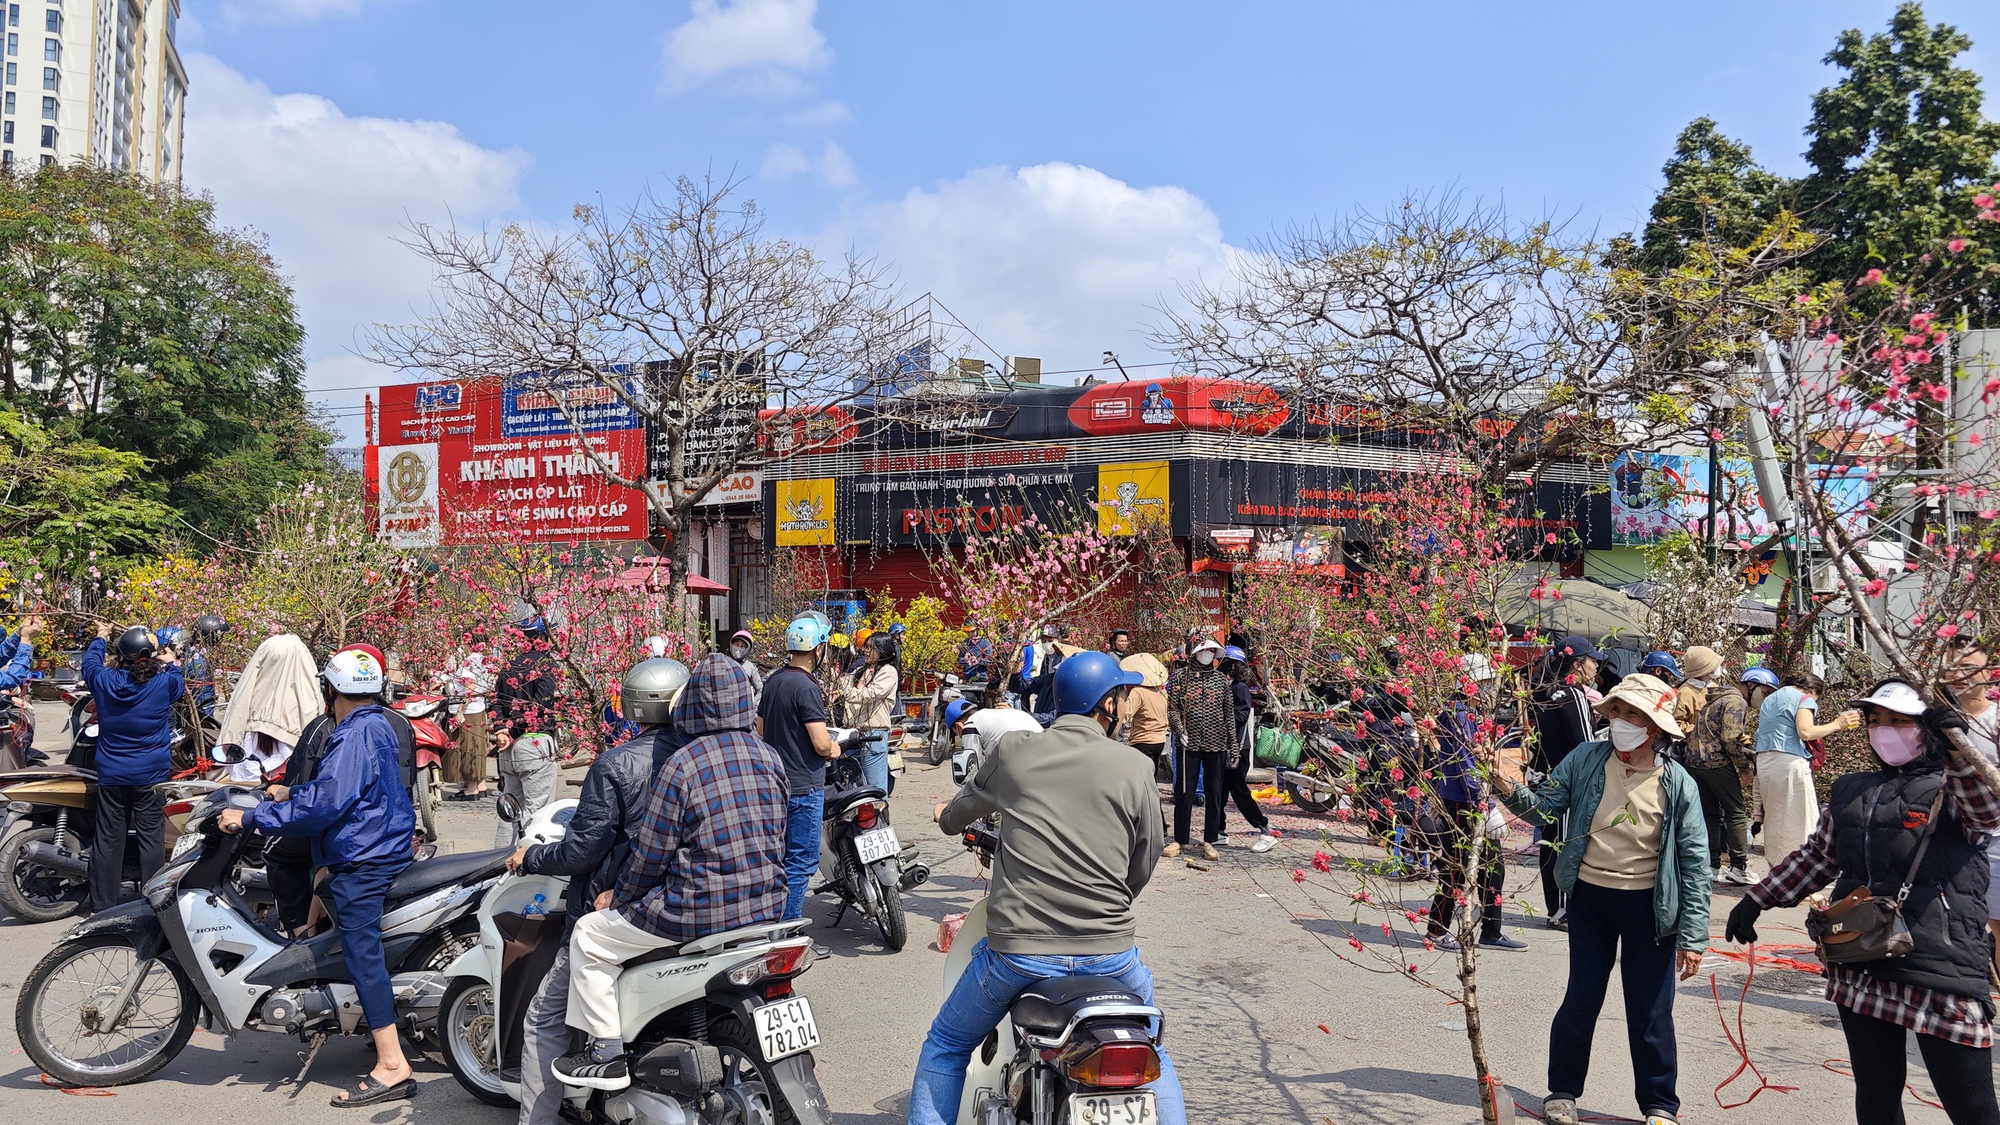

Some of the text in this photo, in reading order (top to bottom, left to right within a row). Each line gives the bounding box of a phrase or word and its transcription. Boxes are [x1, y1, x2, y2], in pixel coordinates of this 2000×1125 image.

[714, 424, 750, 436] BOXING
[474, 442, 522, 453] SHOWROOM
[460, 448, 620, 482] KHÁNH THÀNH
[718, 475, 755, 492] CAO
[855, 481, 881, 493] TRUNG
[882, 479, 899, 491] TÂM
[1042, 475, 1054, 485] XE
[532, 506, 565, 521] SINH
[567, 503, 597, 519] CAO
[599, 500, 628, 518] CẤP
[1260, 504, 1277, 517] TRA
[902, 505, 1023, 535] PISTON
[861, 830, 890, 849] 29-B1
[862, 840, 898, 862] 307.02
[196, 925, 232, 934] HONDA
[656, 962, 709, 979] VISION
[1086, 994, 1131, 1003] HONDA
[764, 1000, 806, 1032] 29-C1
[765, 1022, 817, 1058] 782.04
[1086, 1095, 1147, 1125] 29-S7
